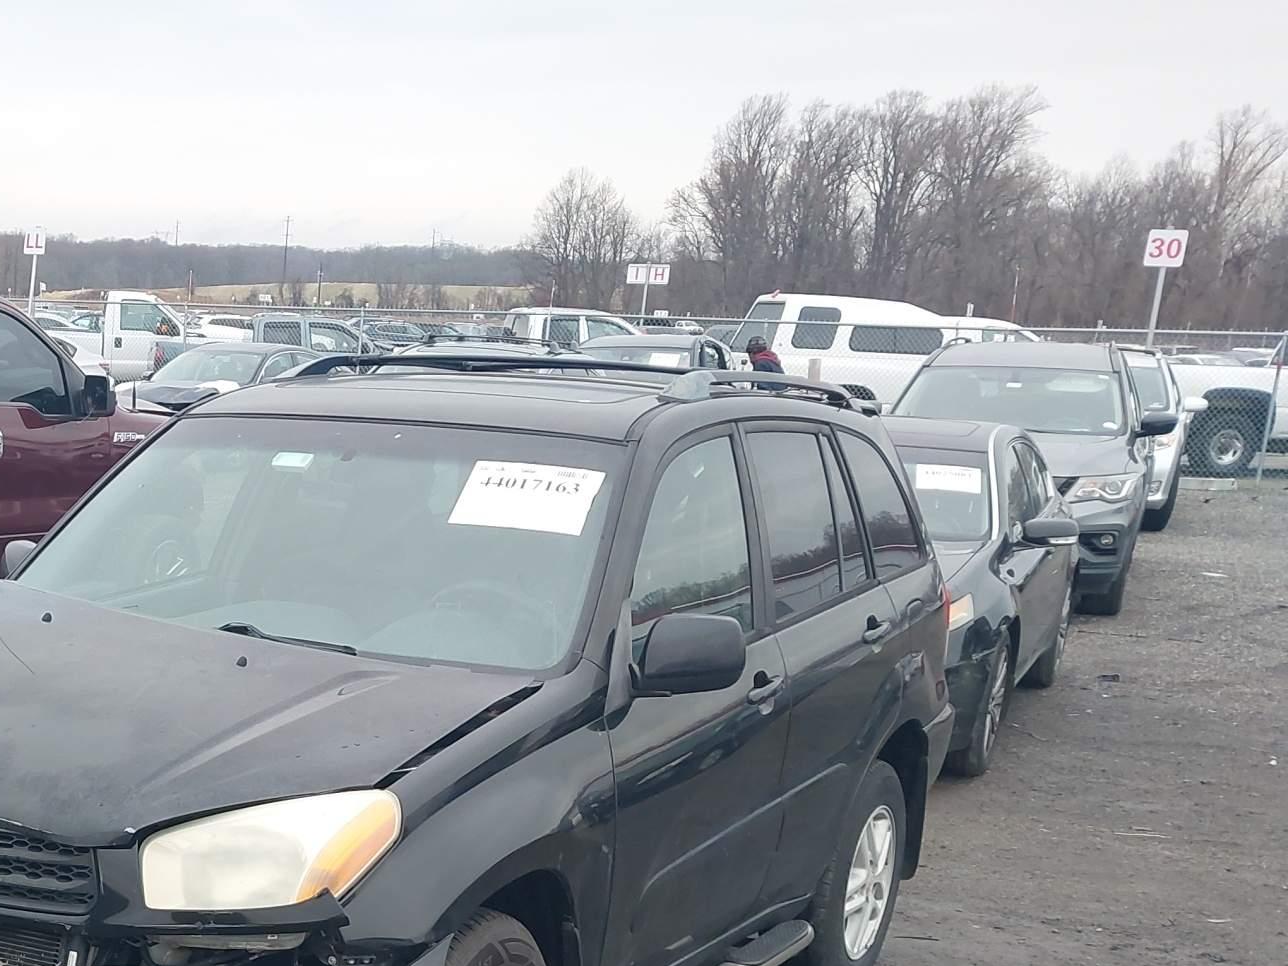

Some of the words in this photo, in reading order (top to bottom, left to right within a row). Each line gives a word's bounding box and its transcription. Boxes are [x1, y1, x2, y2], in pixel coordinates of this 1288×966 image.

[26, 233, 43, 249] LL
[1148, 237, 1182, 259] 30
[654, 267, 665, 281] H
[479, 475, 581, 495] 44017163
